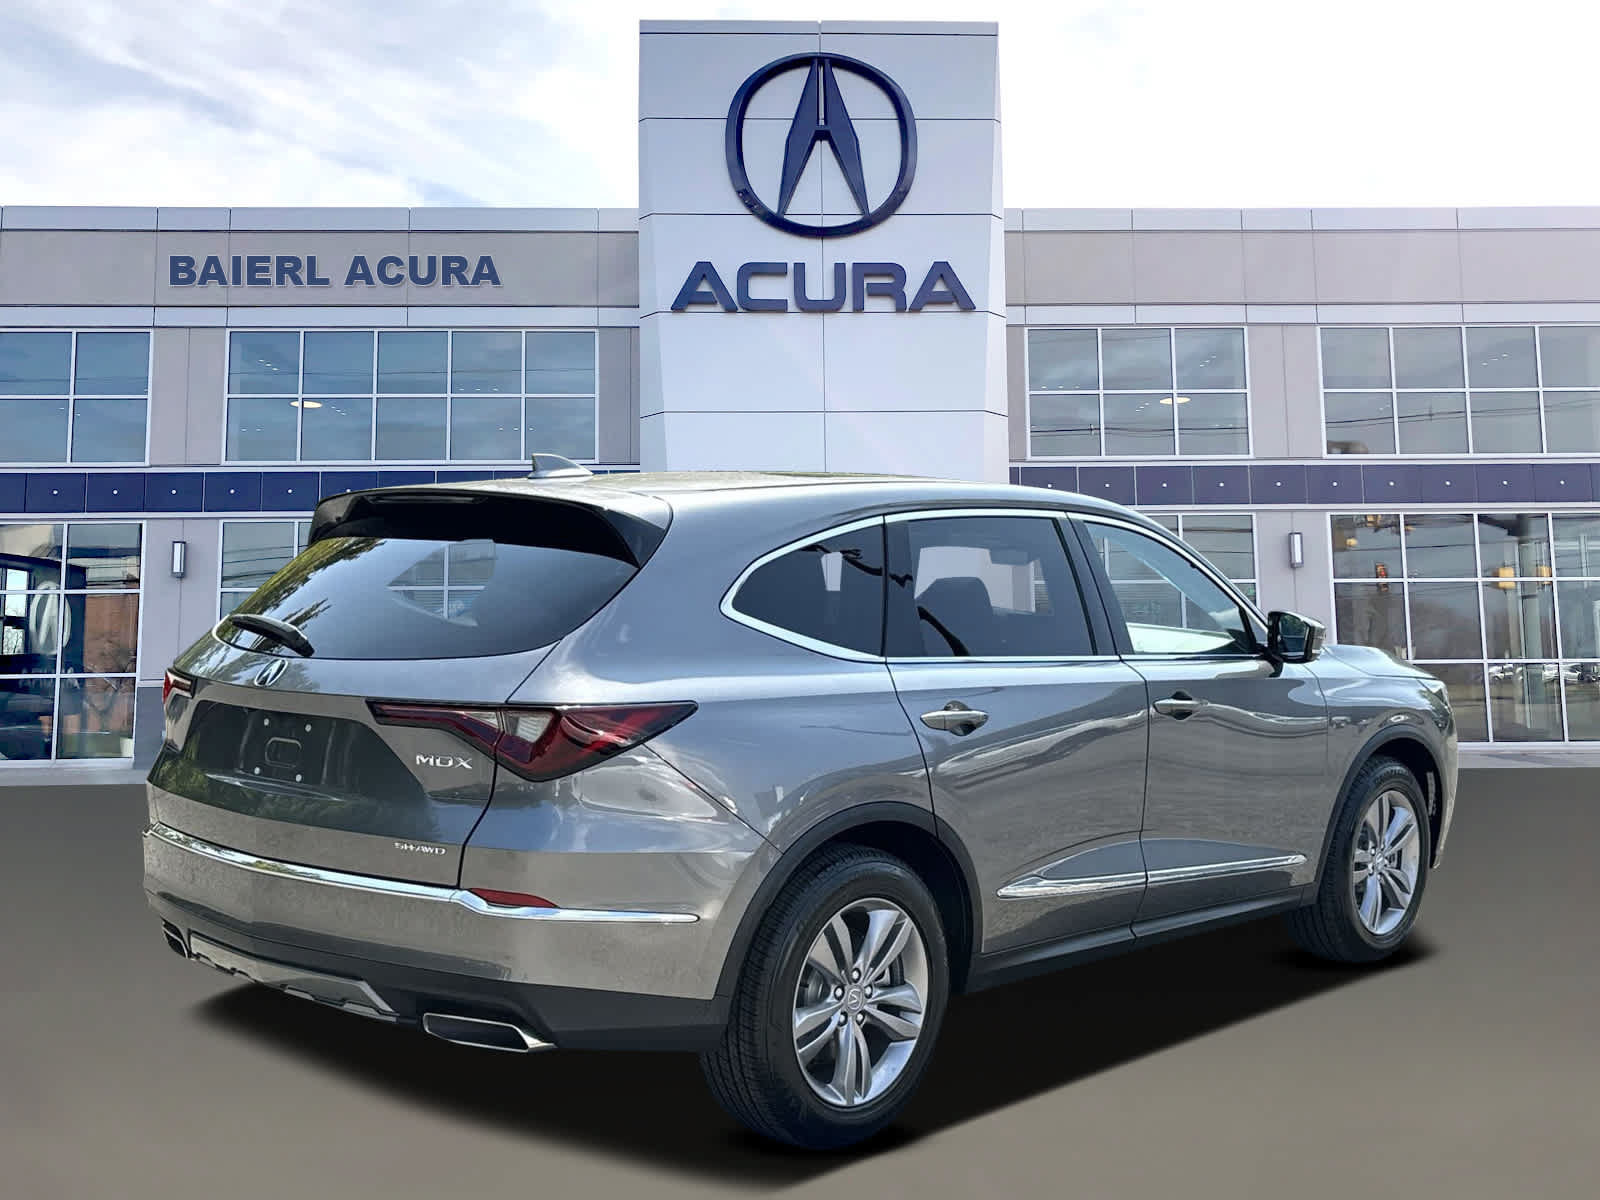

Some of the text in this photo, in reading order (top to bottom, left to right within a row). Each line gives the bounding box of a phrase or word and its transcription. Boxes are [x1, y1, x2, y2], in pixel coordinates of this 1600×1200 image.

[169, 255, 502, 287] BAIERL ACURA
[670, 260, 976, 313] ACURA
[416, 754, 472, 769] MDX
